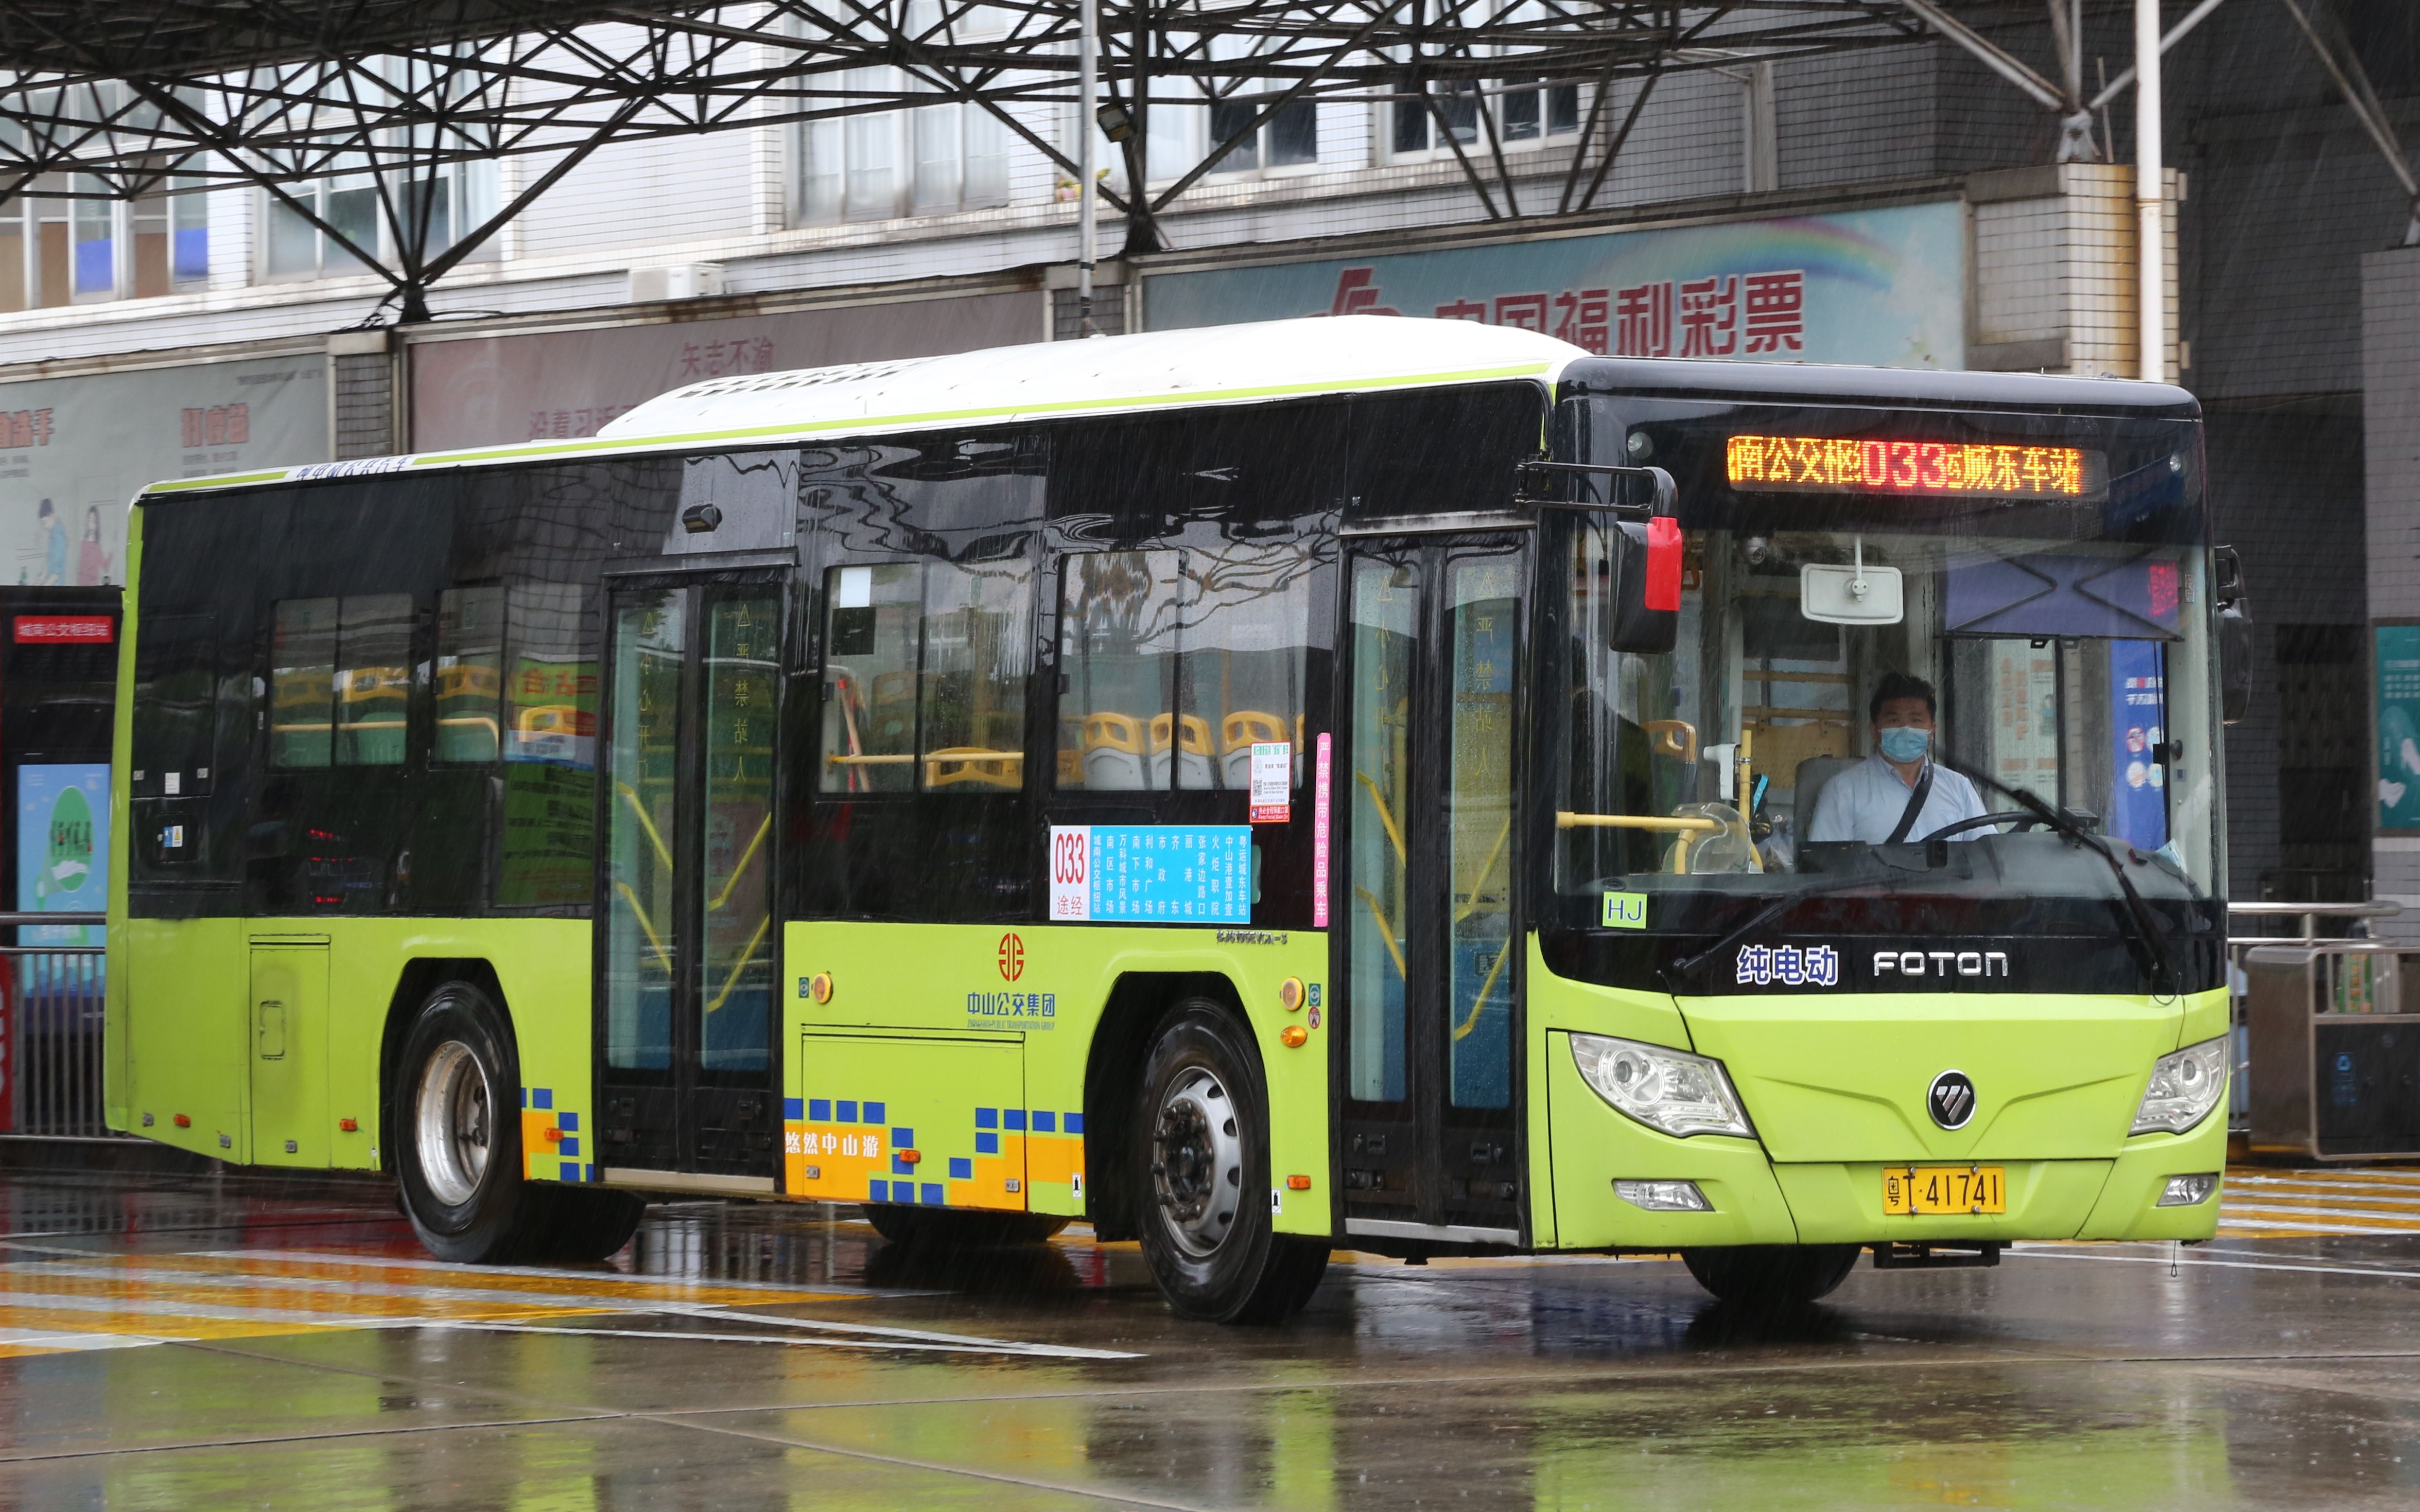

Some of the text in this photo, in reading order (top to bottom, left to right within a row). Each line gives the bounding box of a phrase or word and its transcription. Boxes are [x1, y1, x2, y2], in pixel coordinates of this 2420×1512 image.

[680, 335, 774, 376] 矢志不渝
[1862, 441, 1946, 488] 033
[1055, 833, 1085, 884] 033
[1315, 742, 1331, 918] 严禁携带危险品乘车
[1057, 894, 1083, 916] 途经
[1093, 835, 1101, 913] 城南公交枢纽站
[1106, 835, 1114, 914] 南区市场
[1119, 835, 1127, 914] 万科城市风景
[1131, 835, 1140, 915] 南下市场
[1144, 835, 1153, 915] 利和广场
[1157, 835, 1167, 915] 市政府
[1171, 835, 1180, 915] 齐东
[1184, 835, 1193, 915] 丽港城
[1198, 835, 1206, 915] 张家边路口
[1211, 835, 1220, 916] 火炬职院
[1224, 835, 1233, 917] 中山港壹加壹
[1238, 835, 1246, 916] 粤运城东车站
[1607, 899, 1643, 921] HJ
[1736, 945, 1839, 987] 纯电动
[1873, 951, 2009, 977] FOTON
[967, 992, 1055, 1017] 中山公交集团
[785, 1131, 879, 1158] 悠然中山游
